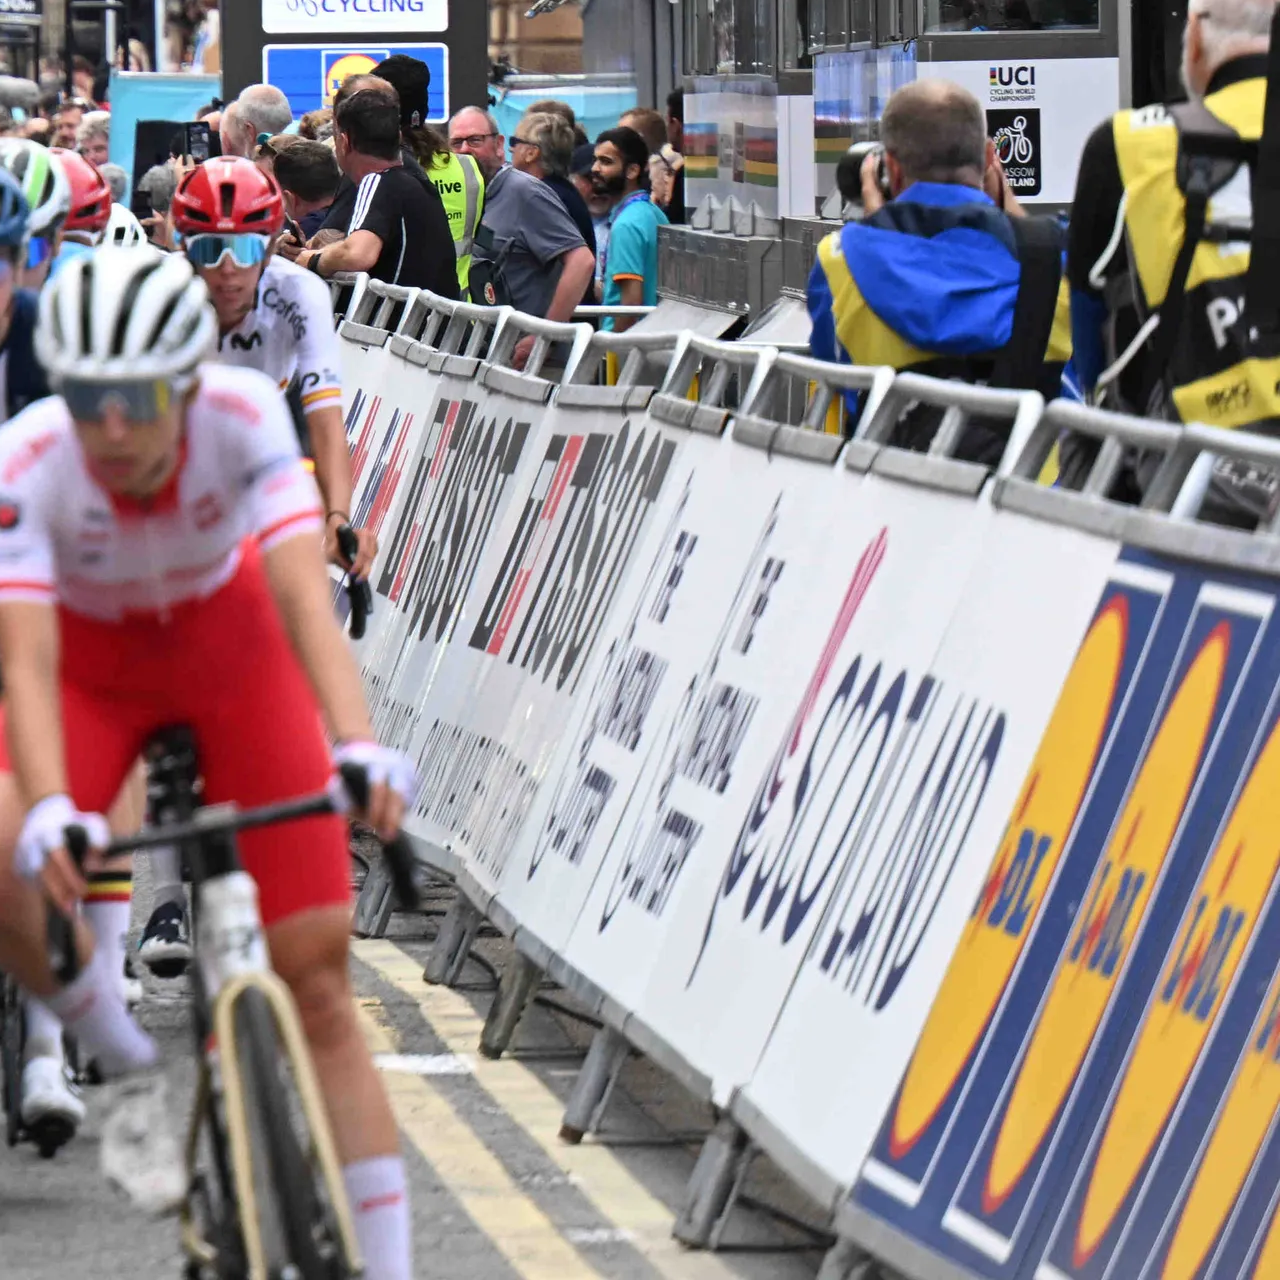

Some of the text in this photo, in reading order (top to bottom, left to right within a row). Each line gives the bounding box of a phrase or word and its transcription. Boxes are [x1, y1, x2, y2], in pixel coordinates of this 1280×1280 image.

[998, 66, 1035, 86] UCI
[1004, 167, 1035, 177] ASGOW
[508, 419, 676, 696] TISSOT
[743, 652, 1009, 1013] SCOTLAND
